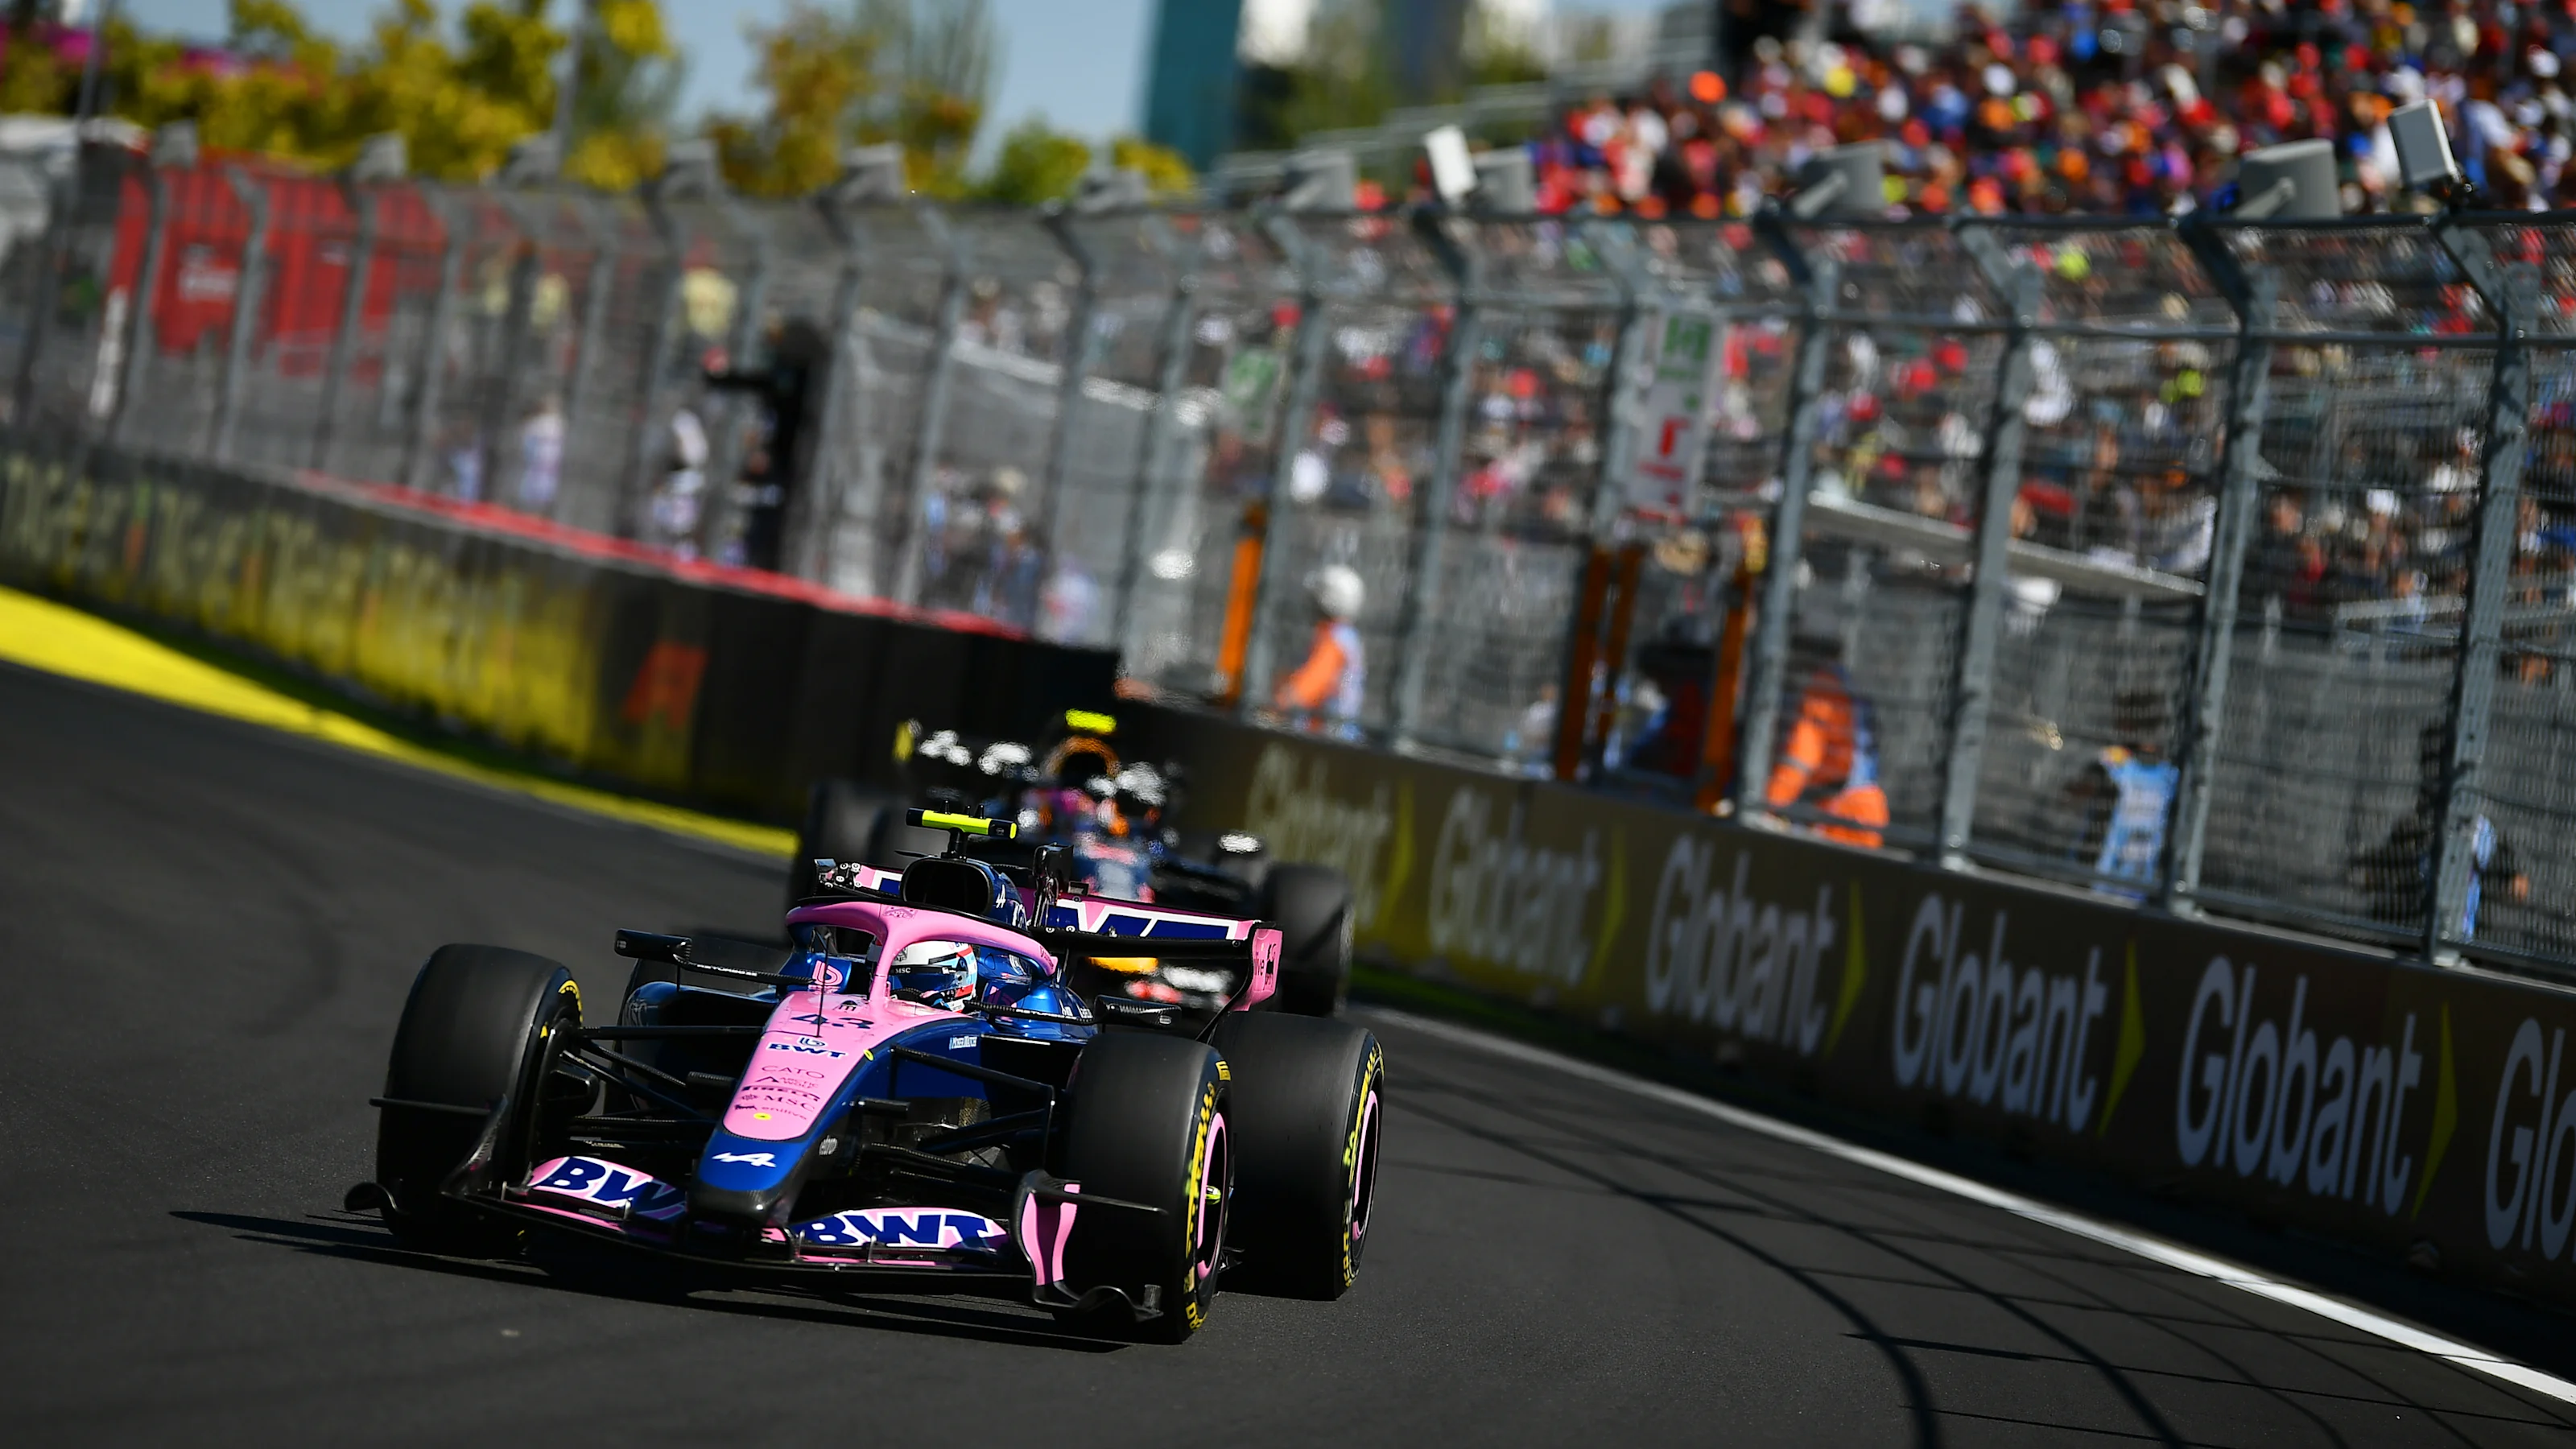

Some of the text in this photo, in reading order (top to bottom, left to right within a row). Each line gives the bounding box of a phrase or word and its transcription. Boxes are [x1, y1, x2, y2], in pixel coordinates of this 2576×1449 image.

[1645, 832, 1836, 1057] Globant
[791, 1013, 875, 1030] 43
[1893, 892, 2107, 1133] Globant
[762, 1065, 824, 1079] CATO
[768, 1043, 846, 1059] BWT
[764, 1094, 815, 1113] MSC
[2177, 955, 2422, 1216] Globant
[2485, 1018, 2576, 1264] Glo
[536, 1156, 687, 1217] BW
[790, 1213, 992, 1250] BWT
